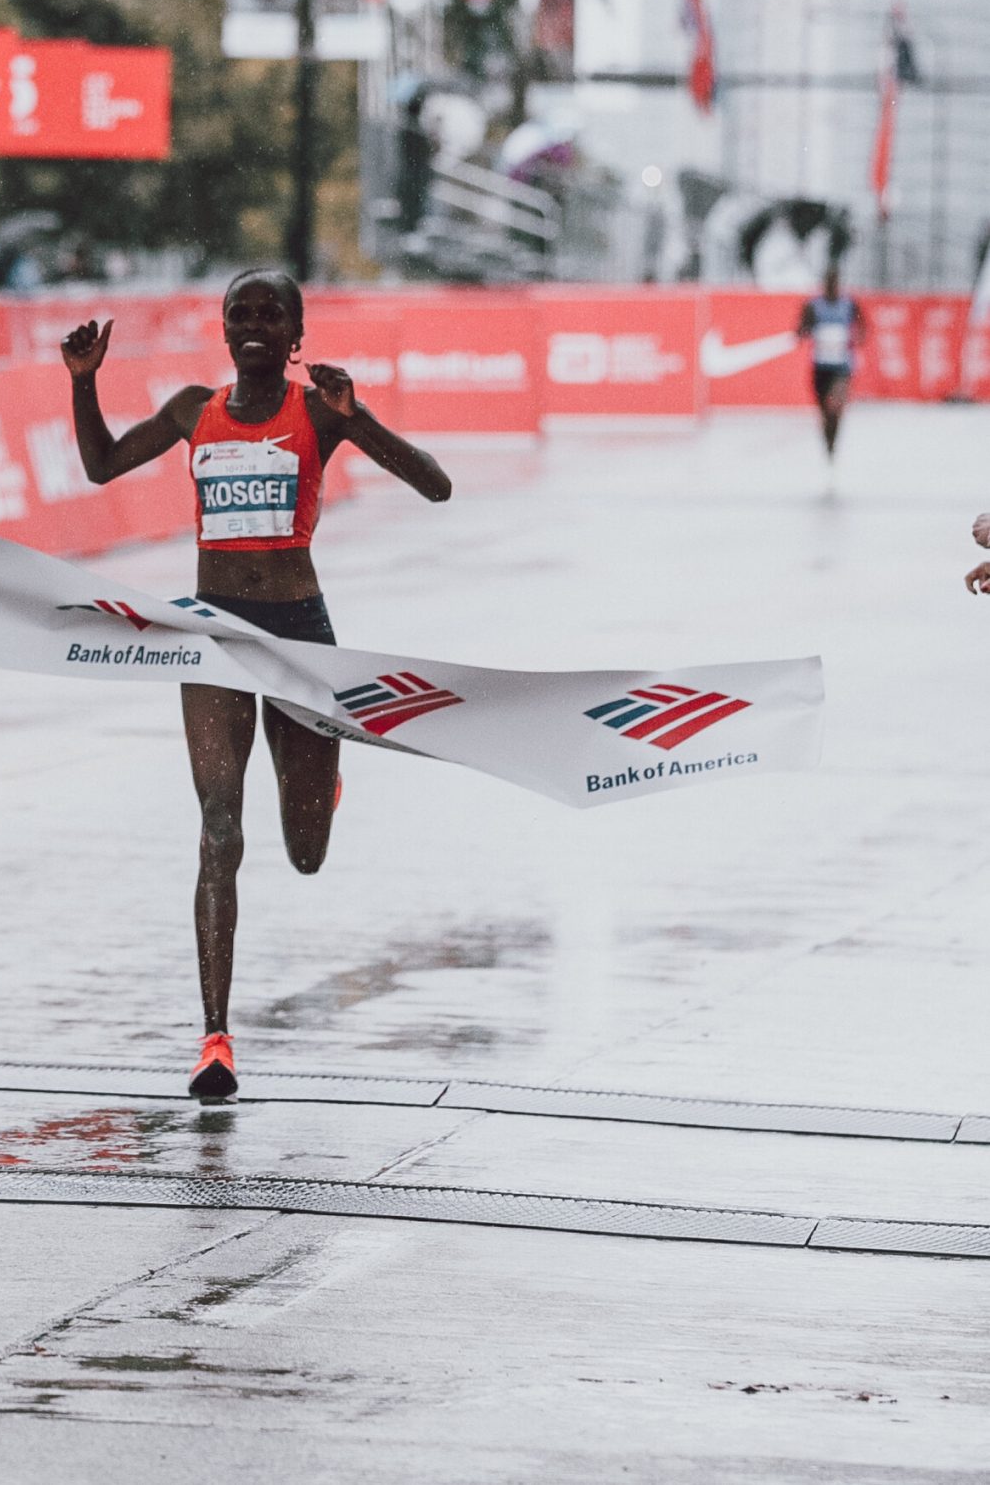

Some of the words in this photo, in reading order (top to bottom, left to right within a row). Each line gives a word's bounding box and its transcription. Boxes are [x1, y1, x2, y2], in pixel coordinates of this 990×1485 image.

[203, 480, 289, 508] KOSGEI
[66, 643, 112, 664] Bank
[114, 644, 134, 665] of
[132, 645, 202, 665] America
[586, 766, 641, 793] Bank
[642, 762, 665, 780] of
[668, 752, 758, 776] America
